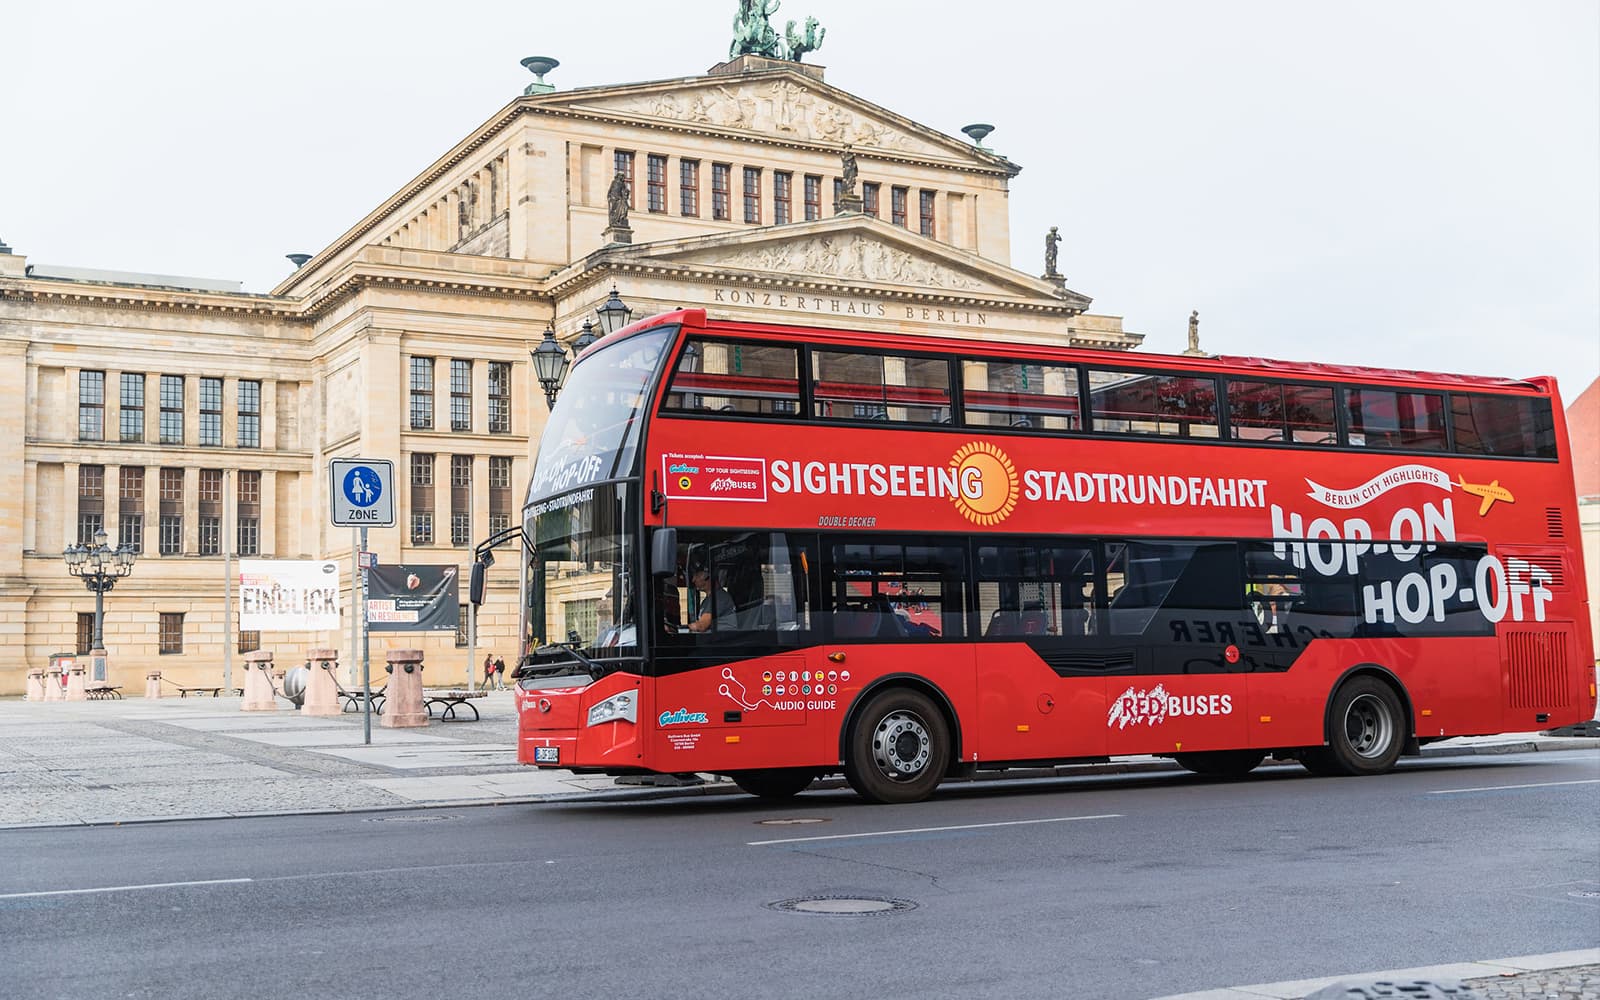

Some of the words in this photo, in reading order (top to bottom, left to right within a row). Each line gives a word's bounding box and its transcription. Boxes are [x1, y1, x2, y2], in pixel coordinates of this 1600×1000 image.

[714, 288, 886, 317] KONZERTHAUS
[905, 306, 988, 325] BERLIN
[551, 455, 603, 493] HOP-OFF
[770, 459, 984, 499] SIGHTSEEING
[1023, 469, 1268, 508] STADTRUNDFAHRT
[1324, 491, 1361, 506] BERLIN
[1362, 481, 1382, 500] CITY
[1382, 469, 1440, 487] HIGHLIGHTS
[348, 509, 379, 520] ZONE
[818, 516, 847, 527] DOUBLE
[848, 516, 877, 527] DECKER
[1270, 498, 1457, 577] HOP-ON
[369, 601, 393, 611] ARTIST
[1362, 554, 1553, 624] HOP-OFF
[369, 613, 377, 621] IN
[774, 700, 805, 711] AUDIO
[806, 700, 837, 711] GUIDE
